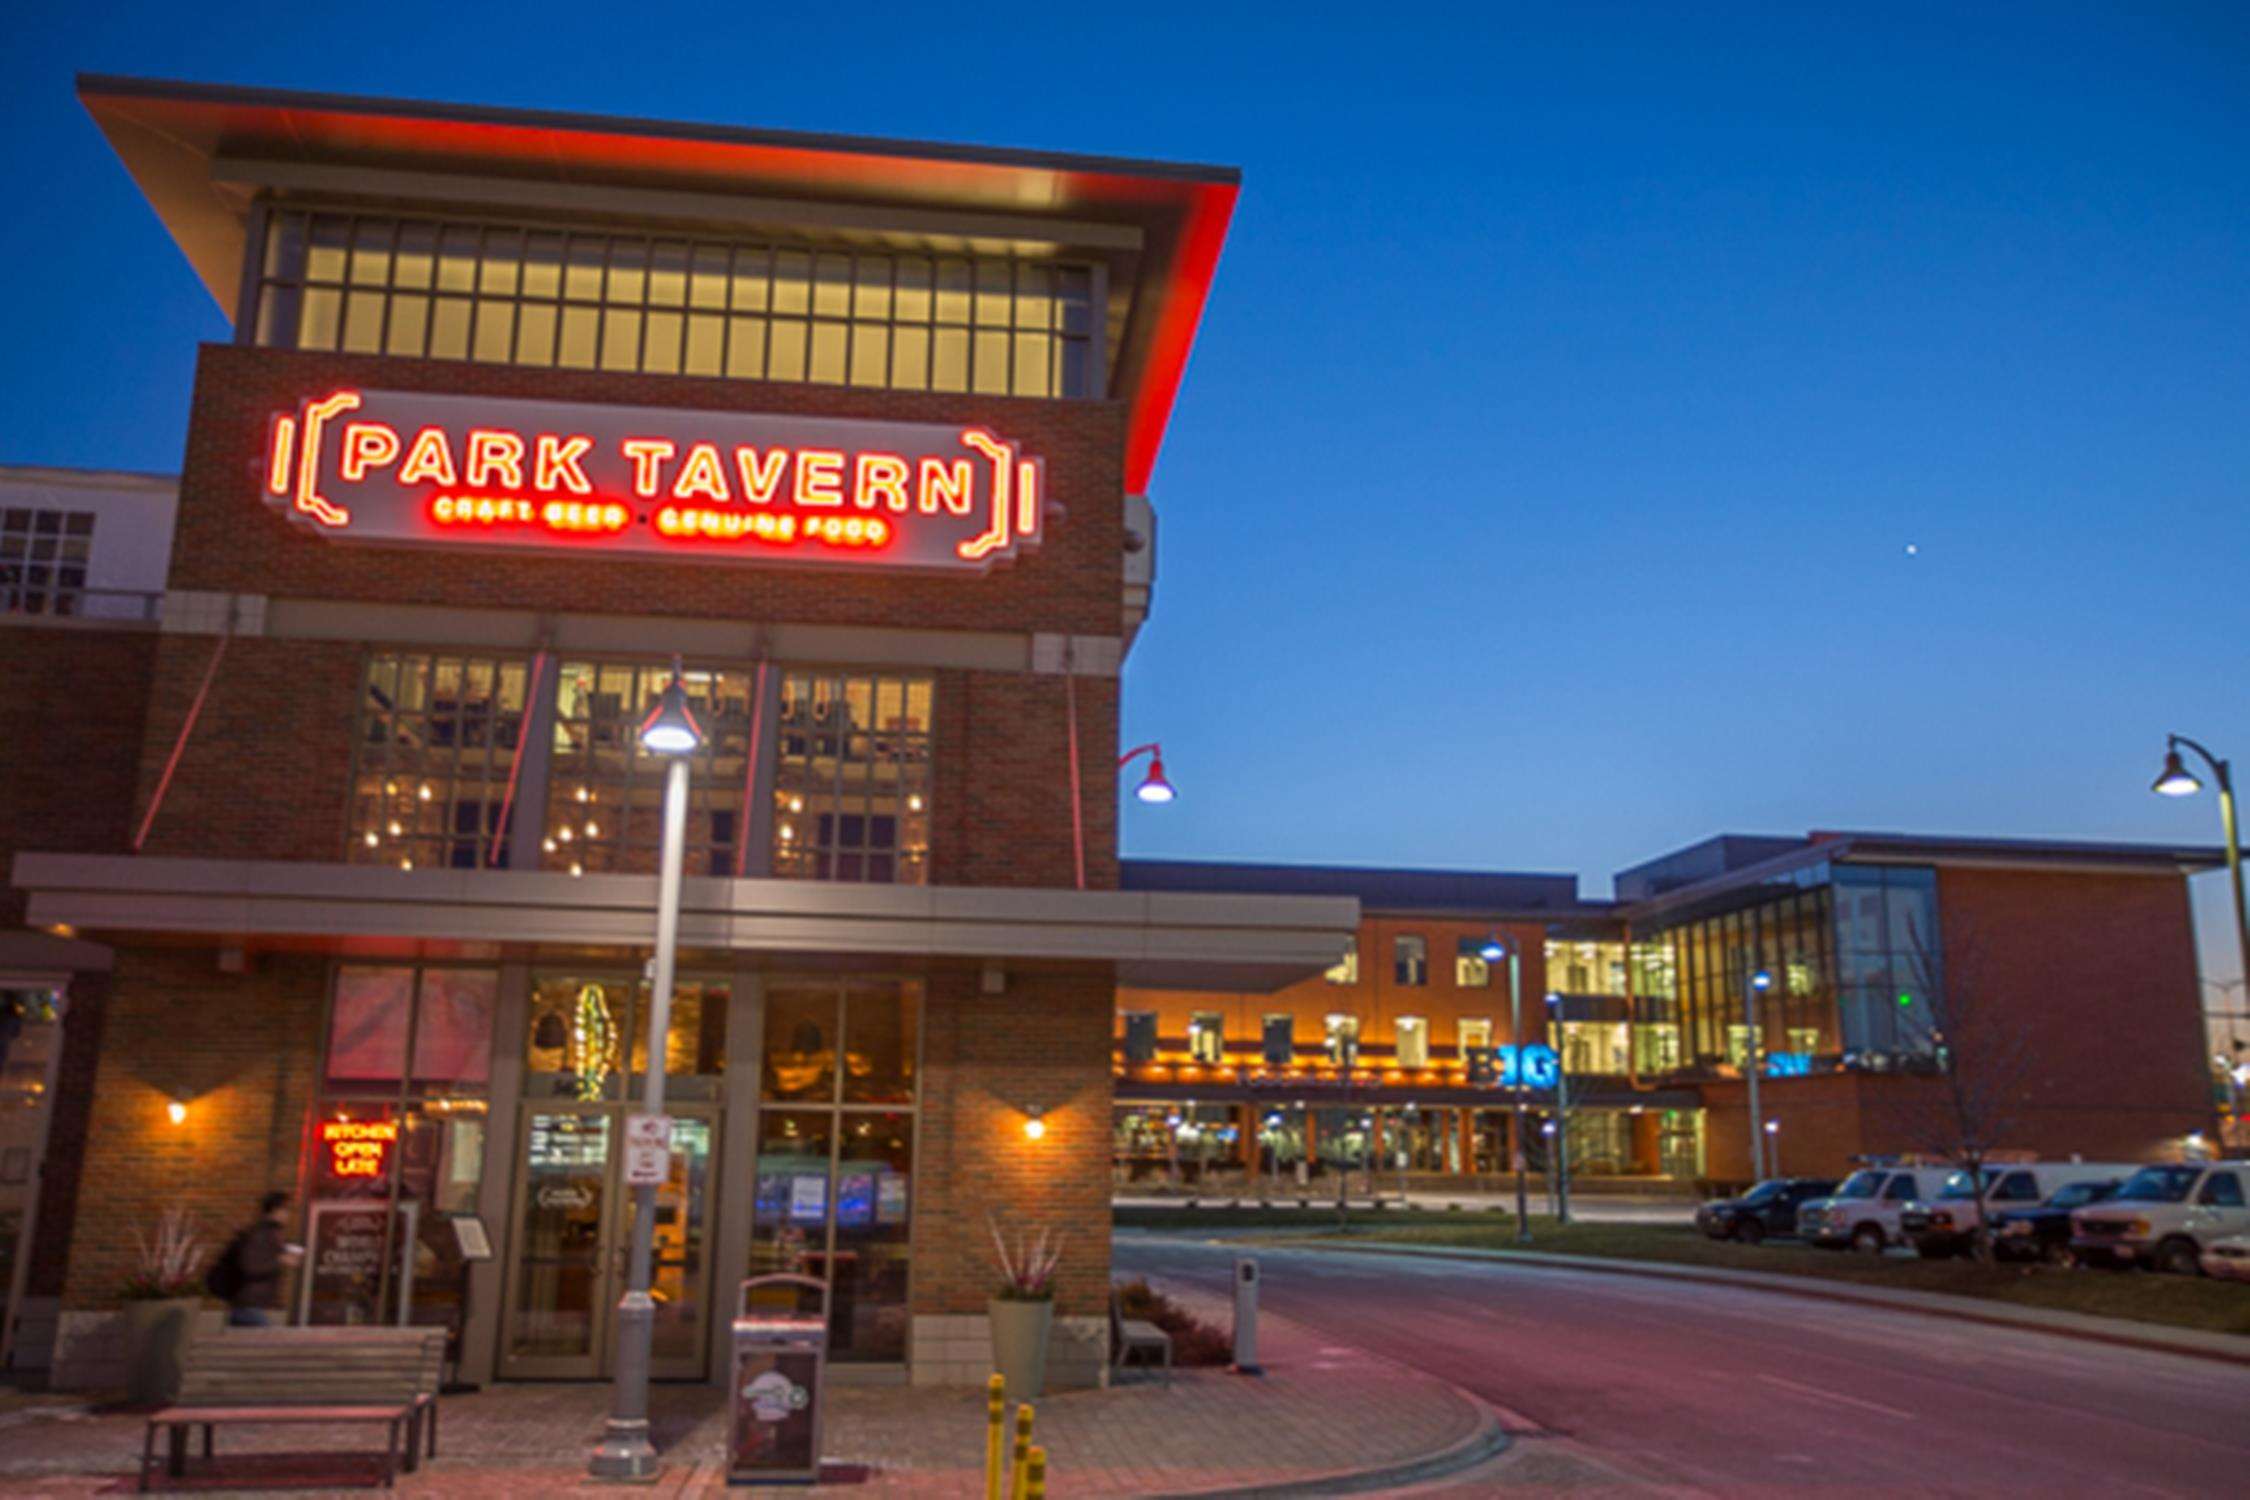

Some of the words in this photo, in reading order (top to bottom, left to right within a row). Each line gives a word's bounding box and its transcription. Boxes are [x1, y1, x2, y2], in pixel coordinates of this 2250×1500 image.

[341, 423, 593, 495] PARK
[623, 439, 974, 515] TAVERN
[433, 496, 534, 524] CRAFT
[543, 502, 629, 533] BEER
[657, 508, 796, 541] GENUINE
[803, 516, 889, 545] FOOD
[324, 1122, 397, 1140] KITCHEN
[333, 1141, 383, 1158] OPEN
[334, 1158, 378, 1175] LATE
